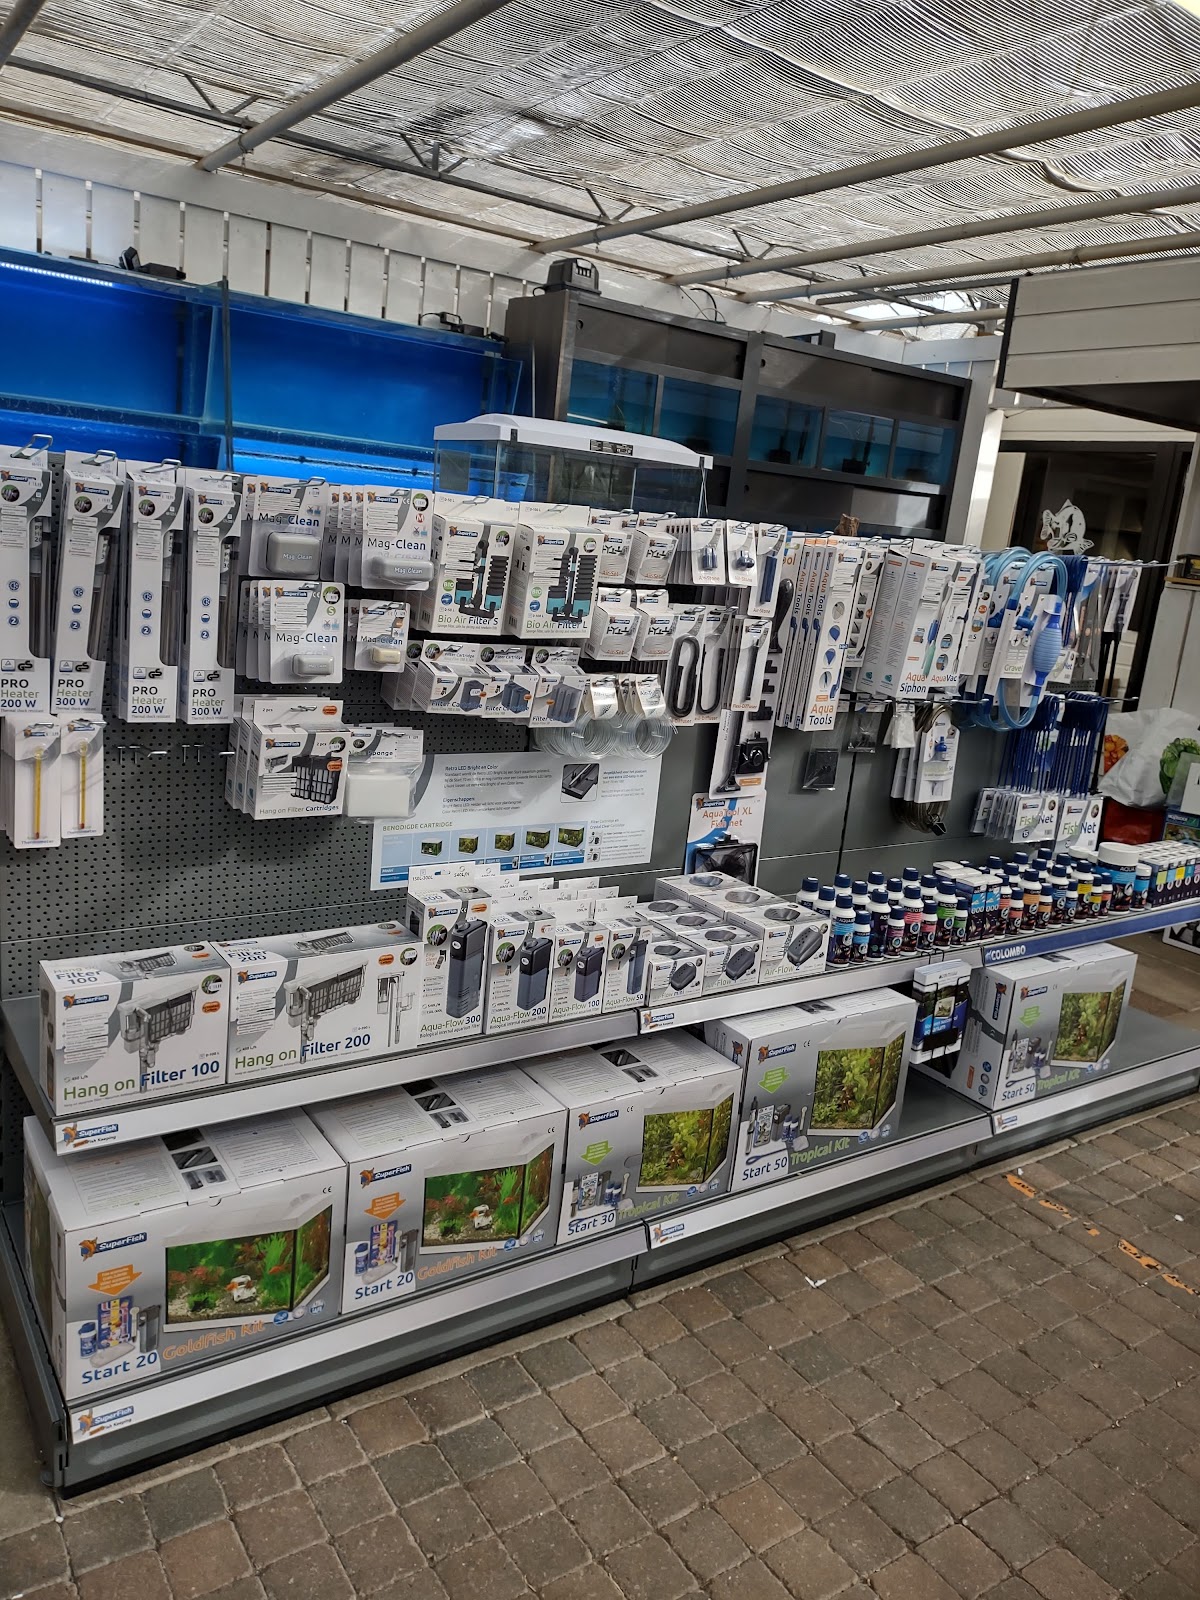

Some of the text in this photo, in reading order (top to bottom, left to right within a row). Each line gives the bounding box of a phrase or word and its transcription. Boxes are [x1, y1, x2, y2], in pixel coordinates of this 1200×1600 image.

[368, 538, 426, 550] Mag-Clean
[794, 571, 806, 614] Aqua Tools
[816, 573, 829, 616] Aqua Tools
[805, 594, 814, 615] Tools
[526, 621, 540, 629] Bio
[541, 621, 555, 629] Air
[276, 633, 338, 644] Mag-Clean
[1004, 664, 1024, 672] Gravel
[906, 672, 926, 682] Aqua
[931, 674, 957, 682] AquaVac
[1, 679, 29, 689] PRO
[58, 679, 84, 688] PRO
[900, 683, 926, 693] Siphon
[1, 689, 39, 699] Heater
[56, 689, 93, 698] Heater
[132, 686, 158, 695] PRO
[193, 689, 216, 697] PRO
[1, 699, 36, 708] 200 W
[56, 698, 90, 706] 300 W
[132, 696, 167, 705] Heater
[192, 698, 225, 707] Heater
[131, 706, 164, 714] 200 W
[191, 707, 222, 716] 300 W
[811, 704, 834, 714] Aqua
[809, 715, 832, 725] Tools
[702, 809, 740, 819] AquaTool
[1020, 815, 1053, 826] Fish Net
[1063, 823, 1096, 835] Fish Net
[228, 951, 267, 960] Filter
[991, 945, 1026, 960] COLOMBO
[241, 954, 267, 963] 200
[56, 971, 101, 980] Filter
[764, 965, 794, 976] Air-Flow
[67, 976, 98, 984] 100
[249, 972, 277, 980] SuperFish
[705, 980, 731, 989] Air-Flow
[1028, 987, 1047, 997] SuperFish
[76, 995, 108, 1004] SuperFish
[605, 996, 635, 1006] Aqua-Flow
[553, 1003, 586, 1014] Aqua-Flow
[491, 1007, 546, 1023] Aqua-Flow 200
[652, 1013, 674, 1021] SuperFish
[421, 1015, 480, 1032] Aqua-Flow 300
[235, 1053, 274, 1069] Hang
[279, 1049, 296, 1060] on
[302, 1042, 341, 1057] Filter
[345, 1034, 371, 1049] 200
[769, 1045, 796, 1056] SuperFish
[63, 1082, 108, 1100] Hang
[115, 1078, 135, 1091] on
[140, 1069, 185, 1086] Filter
[191, 1060, 220, 1077] 100
[1036, 1069, 1081, 1091] Tropical Kit
[1002, 1083, 1035, 1100] Start 50
[590, 1110, 618, 1122] SuperFish
[79, 1124, 118, 1137] SuperFish
[791, 1137, 850, 1166] Tropical Kit
[375, 1165, 411, 1179] SuperFish
[742, 1156, 787, 1181] Start 50
[618, 1192, 680, 1220] Tropical Kit
[567, 1213, 615, 1235] Start 30
[662, 1224, 684, 1234] SuperFish
[99, 1233, 145, 1250] SuperFish
[417, 1246, 497, 1280] Goldfish Kit
[355, 1272, 413, 1300] Start 20
[162, 1320, 266, 1360] Goldfish Kit
[81, 1352, 158, 1384] Start 20
[93, 1406, 132, 1425] SuperFish
[113, 1418, 132, 1428] Keeping
